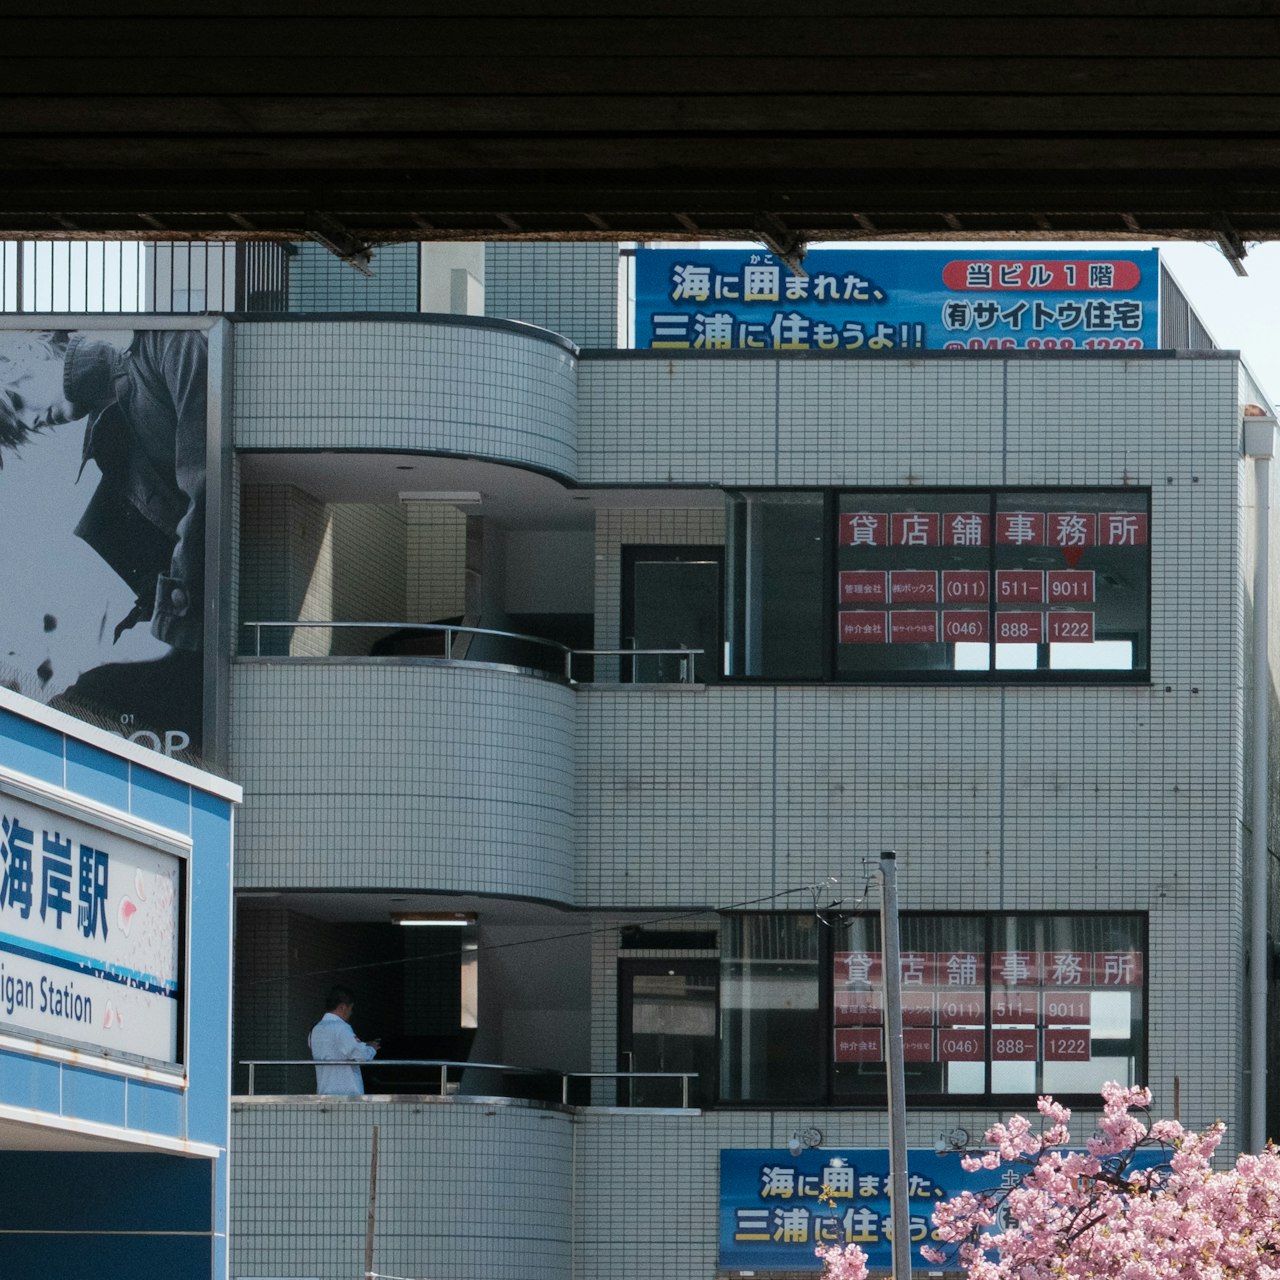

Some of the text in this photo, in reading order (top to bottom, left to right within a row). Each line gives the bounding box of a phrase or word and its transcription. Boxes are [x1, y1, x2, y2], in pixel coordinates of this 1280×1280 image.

[750, 254, 773, 264] かこ
[671, 264, 885, 301] 海に囲まれた、
[848, 515, 1139, 547] 貸店舗事務所
[947, 581, 985, 597] (011)
[1052, 581, 1088, 596] 9011
[844, 624, 882, 635] 仲介会社
[946, 622, 983, 637] (046)
[1053, 622, 1089, 637] 1222
[844, 954, 1136, 986] 貸店舗事務所
[40, 975, 92, 1024] Station
[942, 1003, 981, 1019] (011)
[1049, 1003, 1084, 1018] 9011
[942, 1041, 979, 1055] (046)
[1049, 1041, 1086, 1054] 1222
